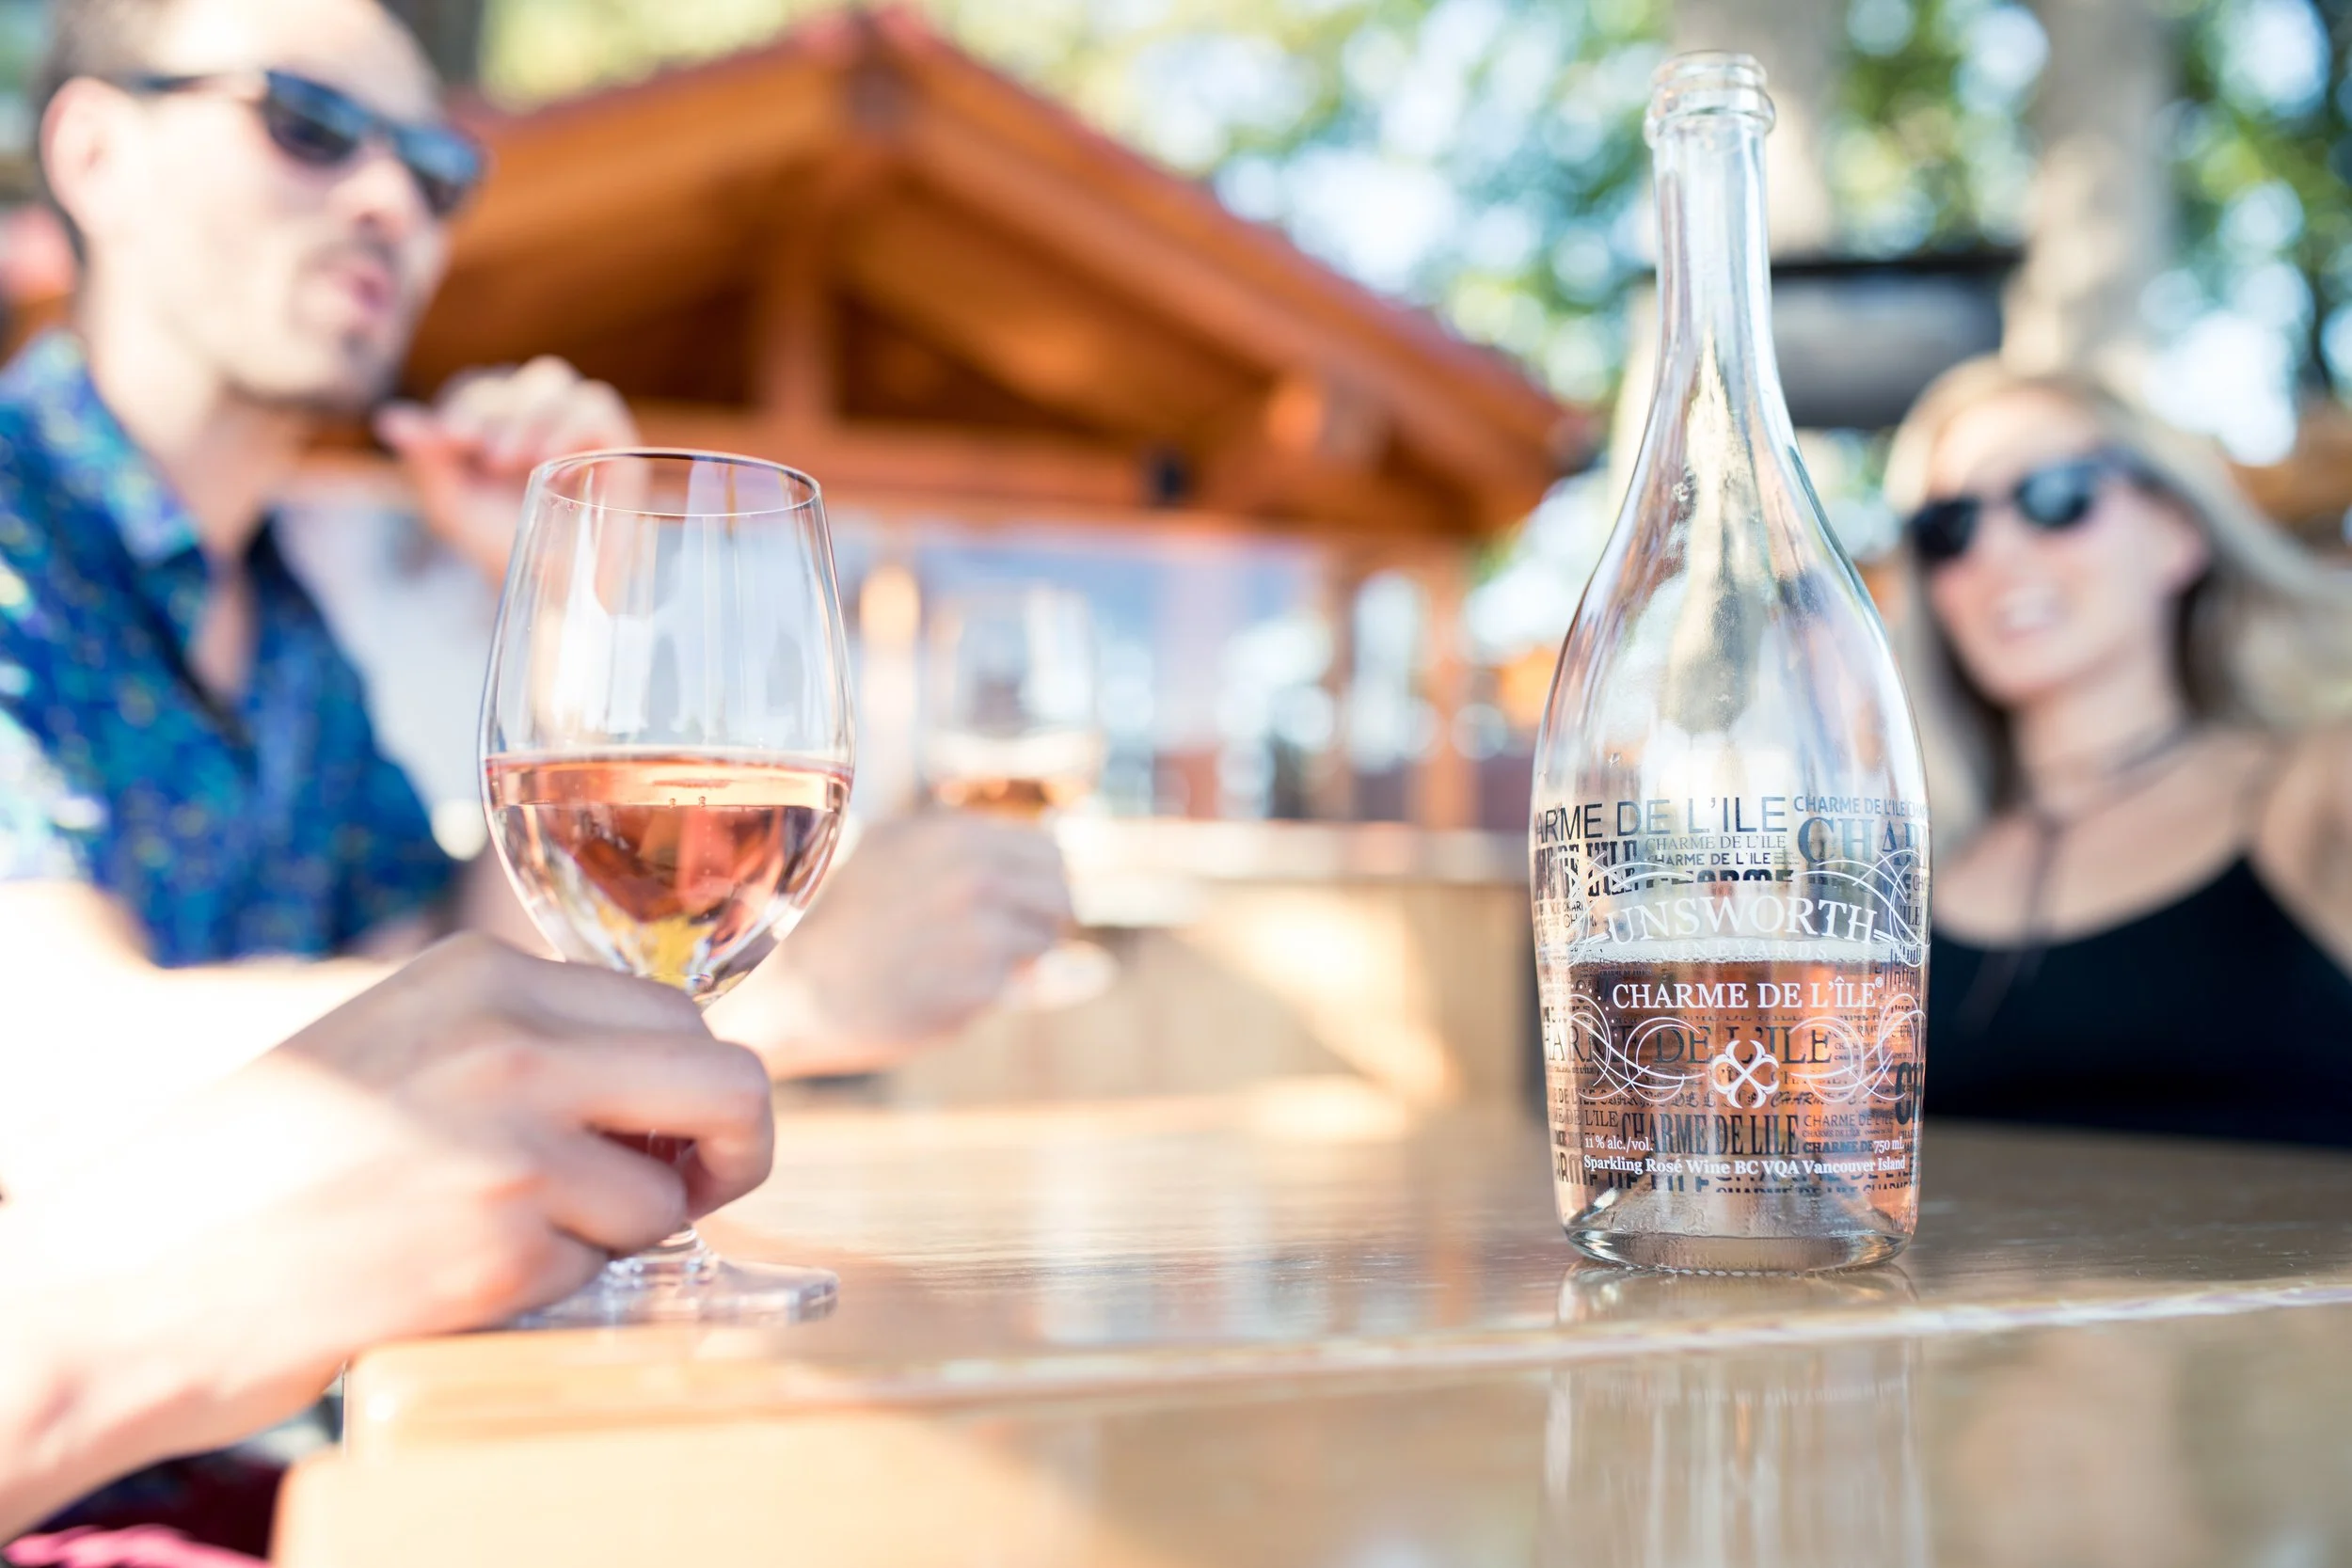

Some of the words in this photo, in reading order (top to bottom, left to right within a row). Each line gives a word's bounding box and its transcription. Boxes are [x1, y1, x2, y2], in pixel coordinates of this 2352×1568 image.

[1793, 796, 1860, 815] CHARME
[1864, 799, 1882, 816] DE
[1616, 799, 1671, 838] DE
[1688, 797, 1788, 834] L'ILE
[1646, 835, 1715, 851] CHARME
[1720, 834, 1742, 849] DE
[1746, 835, 1787, 848] L'ILE
[1647, 853, 1706, 866] CHARME
[1710, 852, 1730, 866] DE
[1736, 852, 1772, 865] L'ILE
[1607, 895, 1878, 945] UNSWORTH
[1656, 940, 1829, 960] VINEYARDS
[1613, 983, 1749, 1008] CHARME
[1756, 983, 1803, 1008] DE
[1654, 1025, 1713, 1065] DE
[1725, 1026, 1832, 1065] L'ILE
[1585, 1110, 1619, 1129] L'ILE
[1804, 1114, 1855, 1128] CHARME
[1858, 1114, 1871, 1126] DE
[1607, 1135, 1654, 1153] alc./vol.
[1622, 1112, 1708, 1155] CHARME
[1713, 1115, 1744, 1156] DE
[1803, 1140, 1857, 1154] CHARME
[1861, 1139, 1873, 1153] DE
[1873, 1139, 1889, 1154] 750
[1892, 1136, 1904, 1150] mL
[1583, 1154, 1643, 1175] Sparkling
[1645, 1158, 1682, 1173] Rosé
[1686, 1160, 1730, 1175] Wine
[1735, 1161, 1759, 1174] BC
[1761, 1161, 1800, 1177] VQA
[1802, 1158, 1875, 1174] Vancouver
[1878, 1155, 1905, 1171] Island
